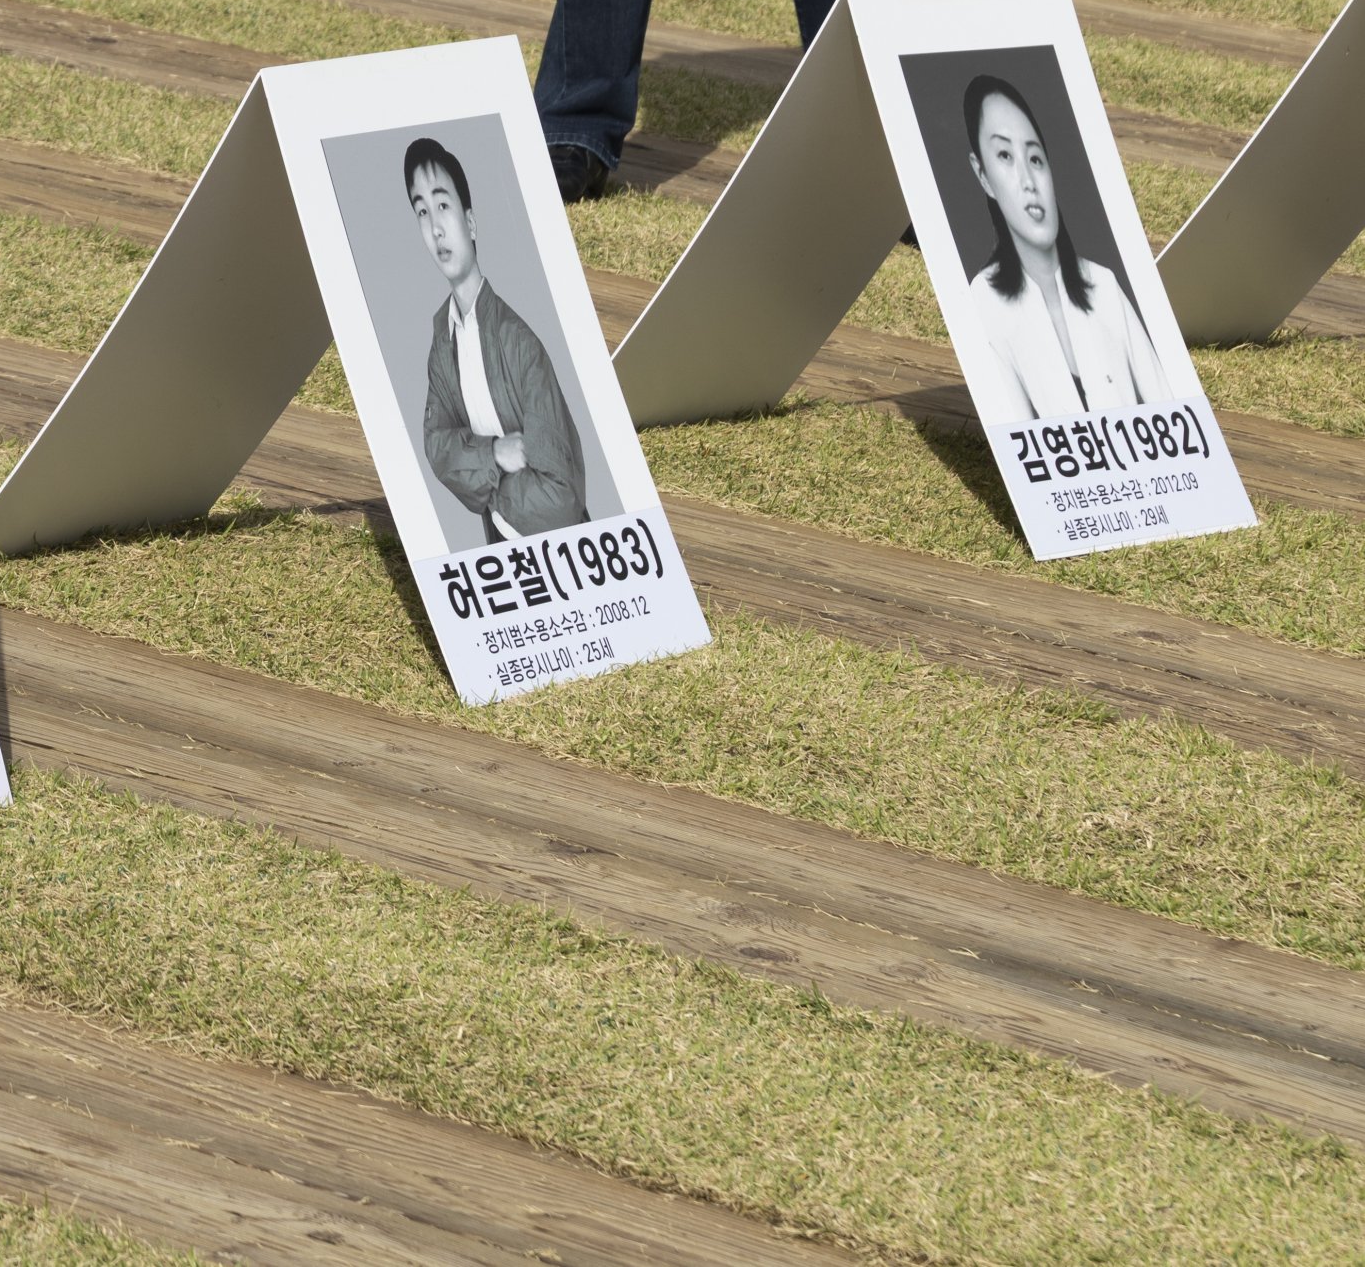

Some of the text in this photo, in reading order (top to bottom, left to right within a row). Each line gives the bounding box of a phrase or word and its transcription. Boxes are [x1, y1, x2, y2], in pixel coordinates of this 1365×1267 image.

[1011, 405, 1209, 483] 김영화(1982)
[1051, 479, 1143, 512] 정치범수용소수감
[1151, 472, 1198, 495] 2012.09
[1064, 511, 1132, 540] 실종당시나이
[1140, 505, 1169, 526] 29세
[439, 518, 663, 619] 허은철(1983)
[483, 611, 587, 653] 정치범수용소수감
[596, 596, 650, 625] 2008.12
[497, 647, 574, 685] 실종당시나이
[587, 636, 614, 663] 25세
